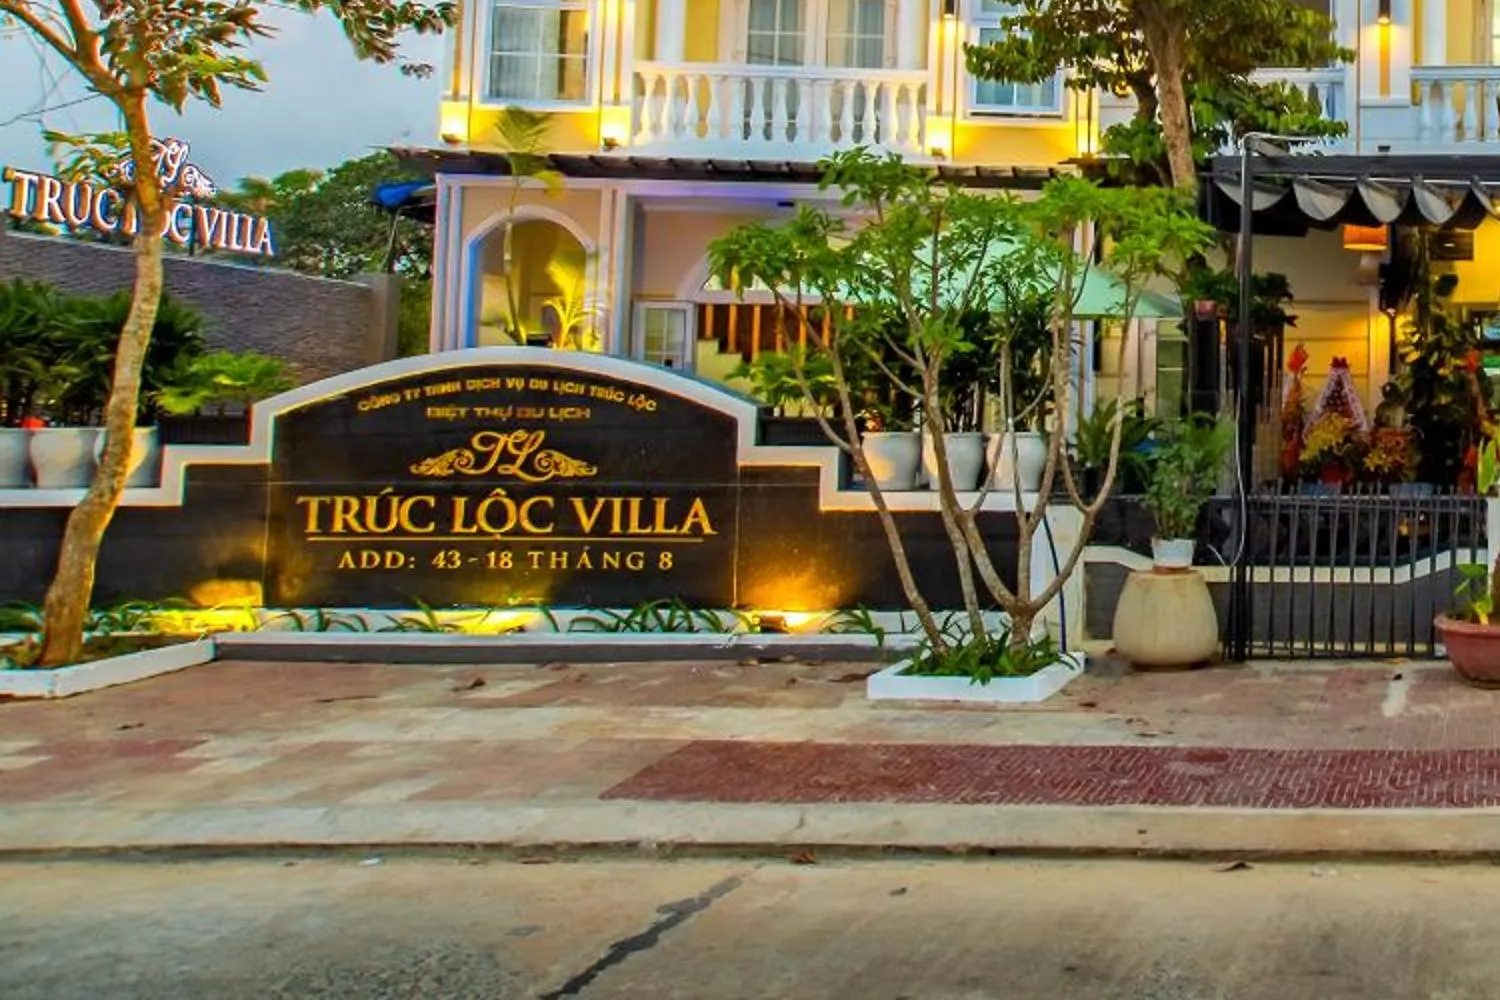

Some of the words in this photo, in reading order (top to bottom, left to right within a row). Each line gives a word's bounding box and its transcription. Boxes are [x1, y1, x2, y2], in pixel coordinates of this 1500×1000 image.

[194, 207, 277, 256] VILLA
[403, 388, 420, 401] TY
[297, 488, 436, 535] TRÚC
[452, 487, 555, 540] LỘC
[570, 495, 718, 535] VILLA
[337, 550, 416, 569] ADD:
[528, 545, 646, 569] THÁNG
[659, 550, 674, 569] 8
